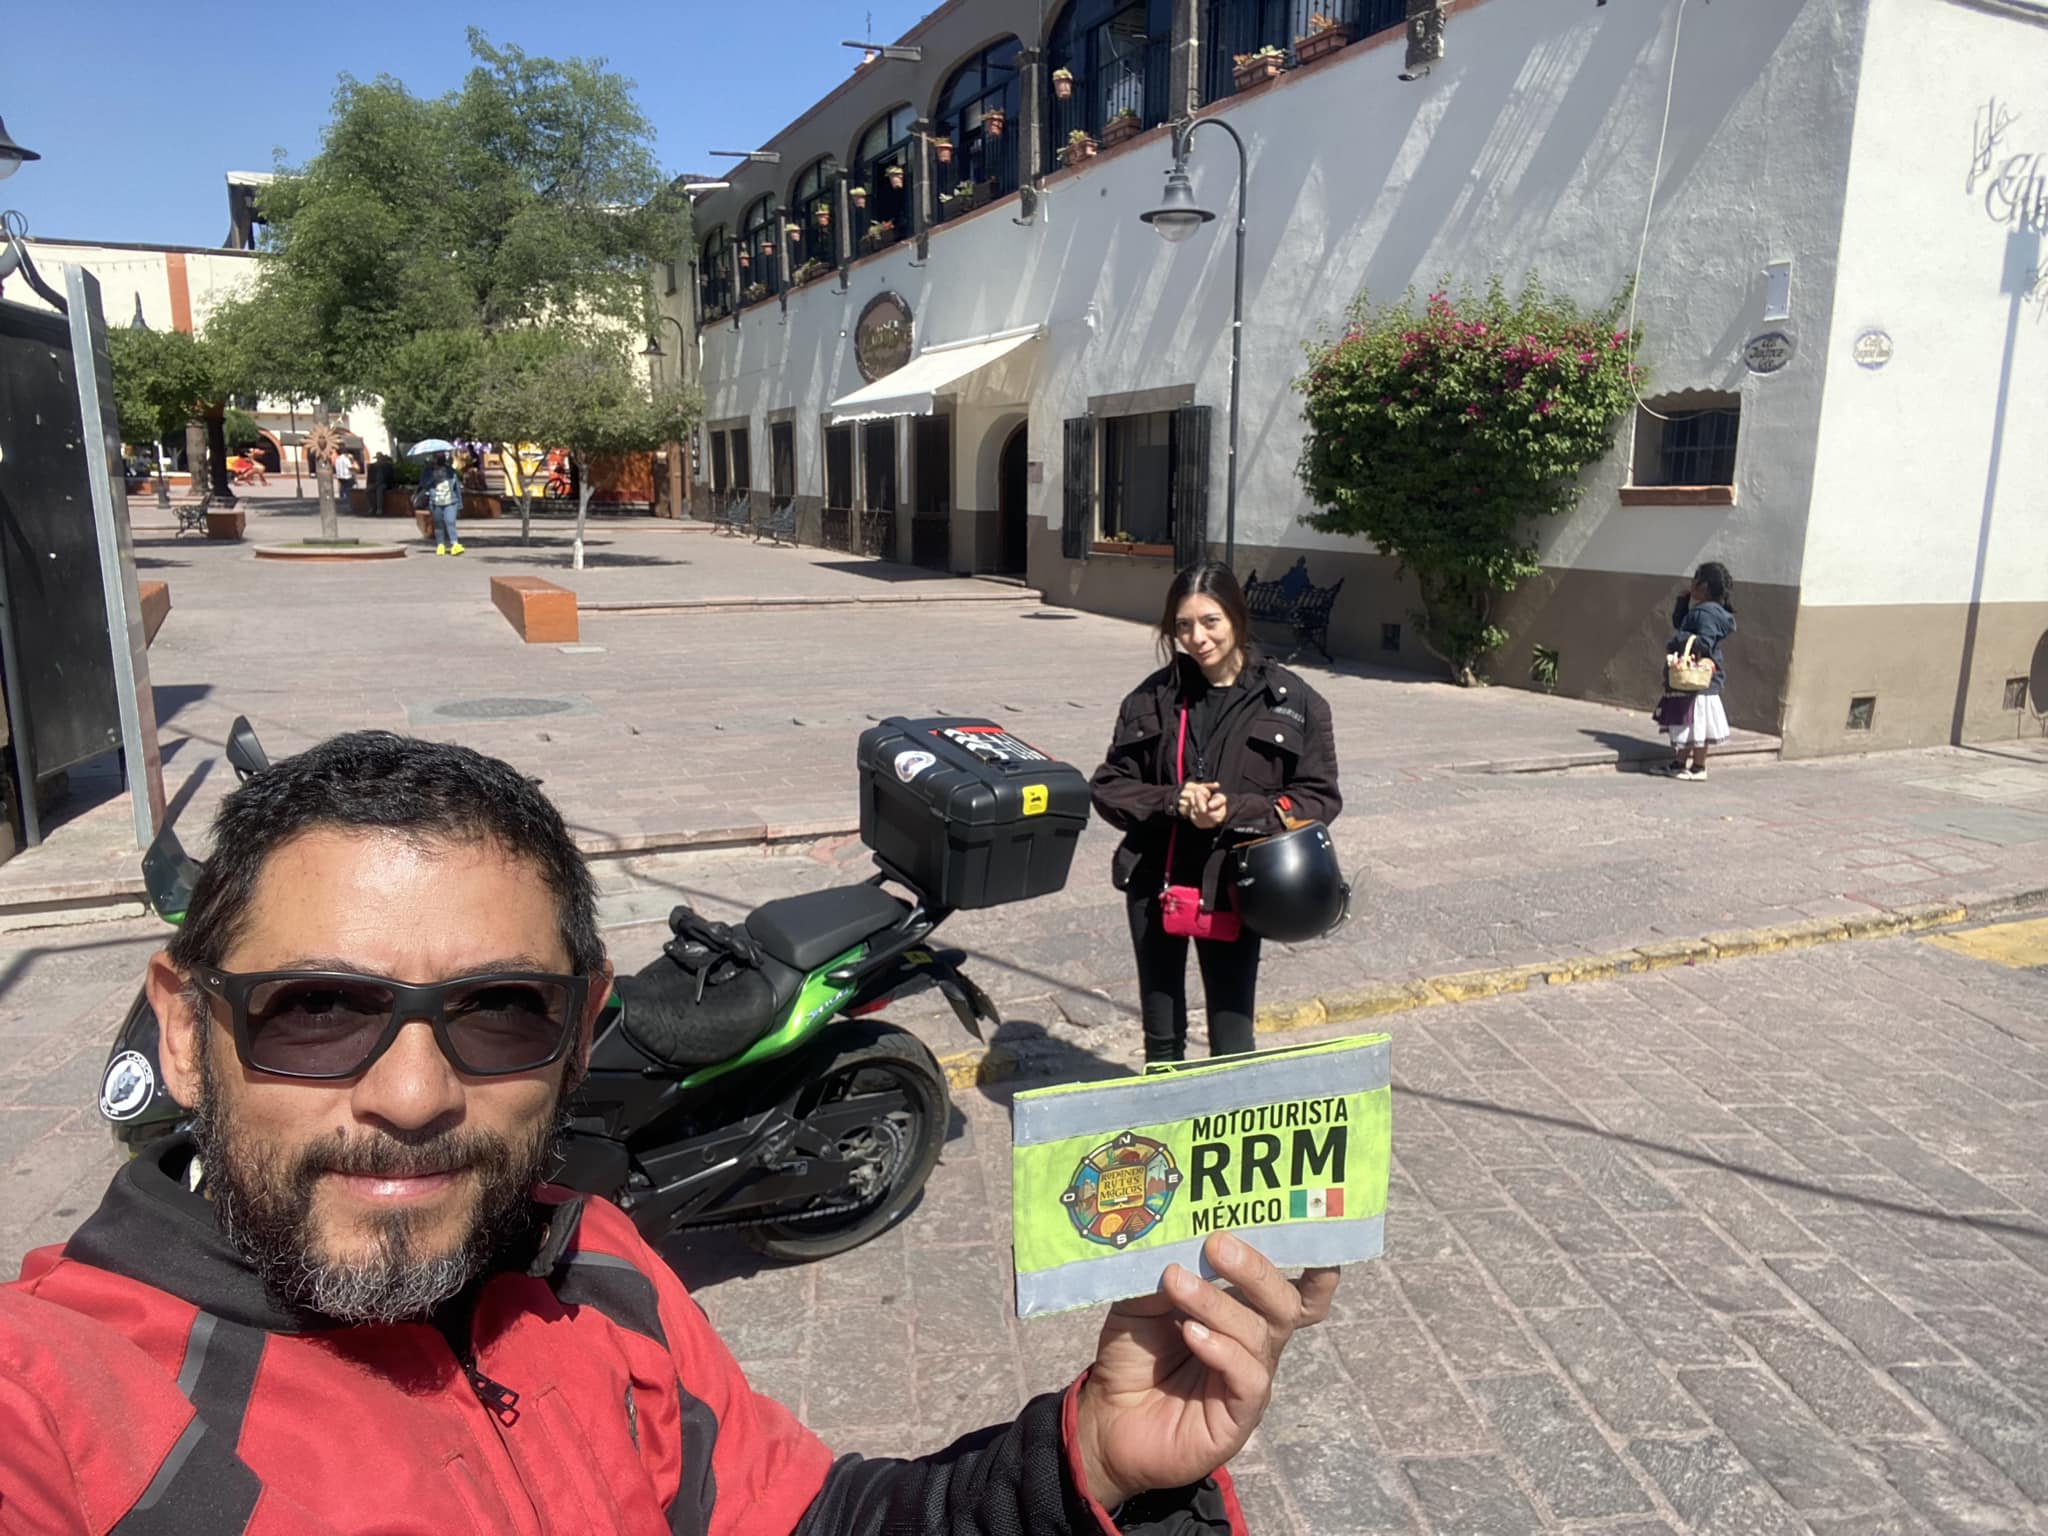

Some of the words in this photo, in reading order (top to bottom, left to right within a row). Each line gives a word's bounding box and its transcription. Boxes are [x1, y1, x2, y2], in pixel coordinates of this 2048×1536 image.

[1191, 1097, 1349, 1142] MOTOTURISTA
[1119, 1134, 1131, 1145] N
[1190, 1125, 1348, 1203] RRM
[1168, 1174, 1179, 1183] E
[1191, 1197, 1282, 1236] MÉXICO
[1116, 1233, 1127, 1245] S
